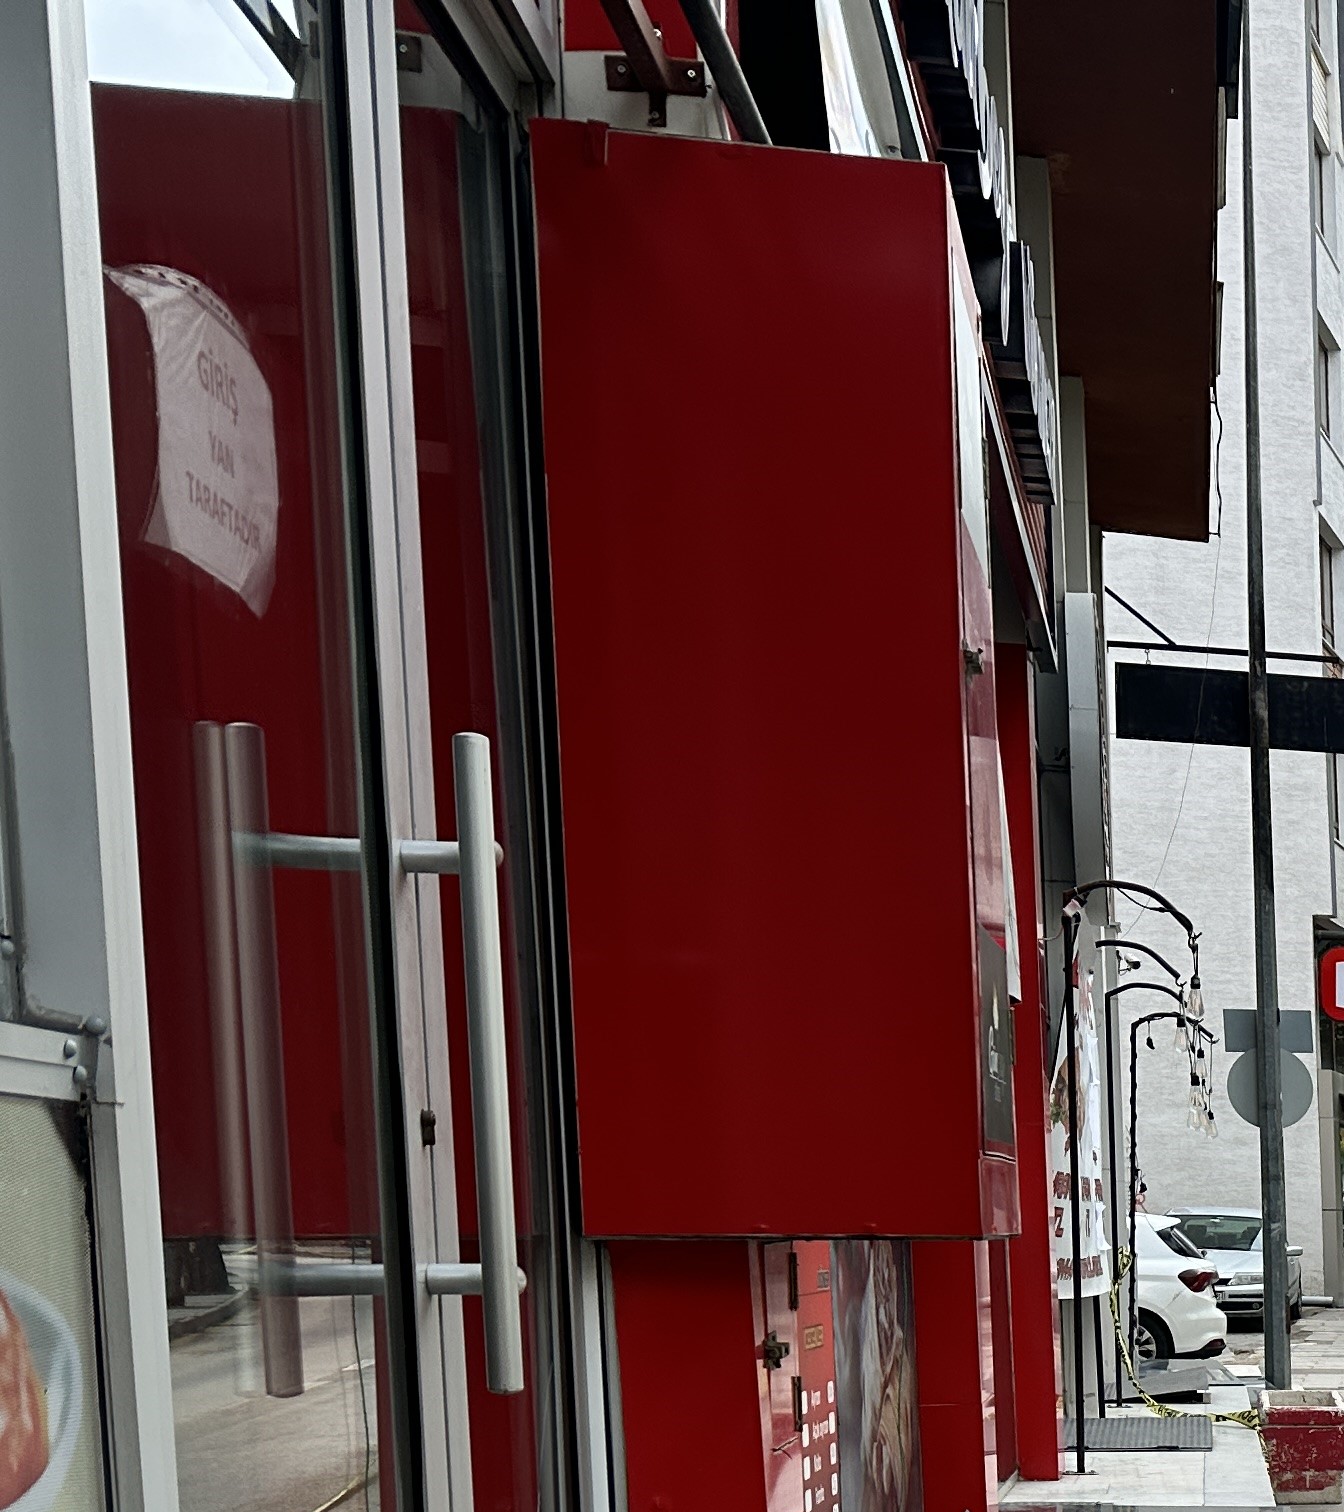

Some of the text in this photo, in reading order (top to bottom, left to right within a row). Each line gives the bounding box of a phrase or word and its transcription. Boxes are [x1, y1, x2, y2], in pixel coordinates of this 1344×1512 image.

[197, 347, 239, 427] GİRİŞ
[208, 429, 235, 479] YAN
[186, 469, 262, 552] TARAFTADIR
